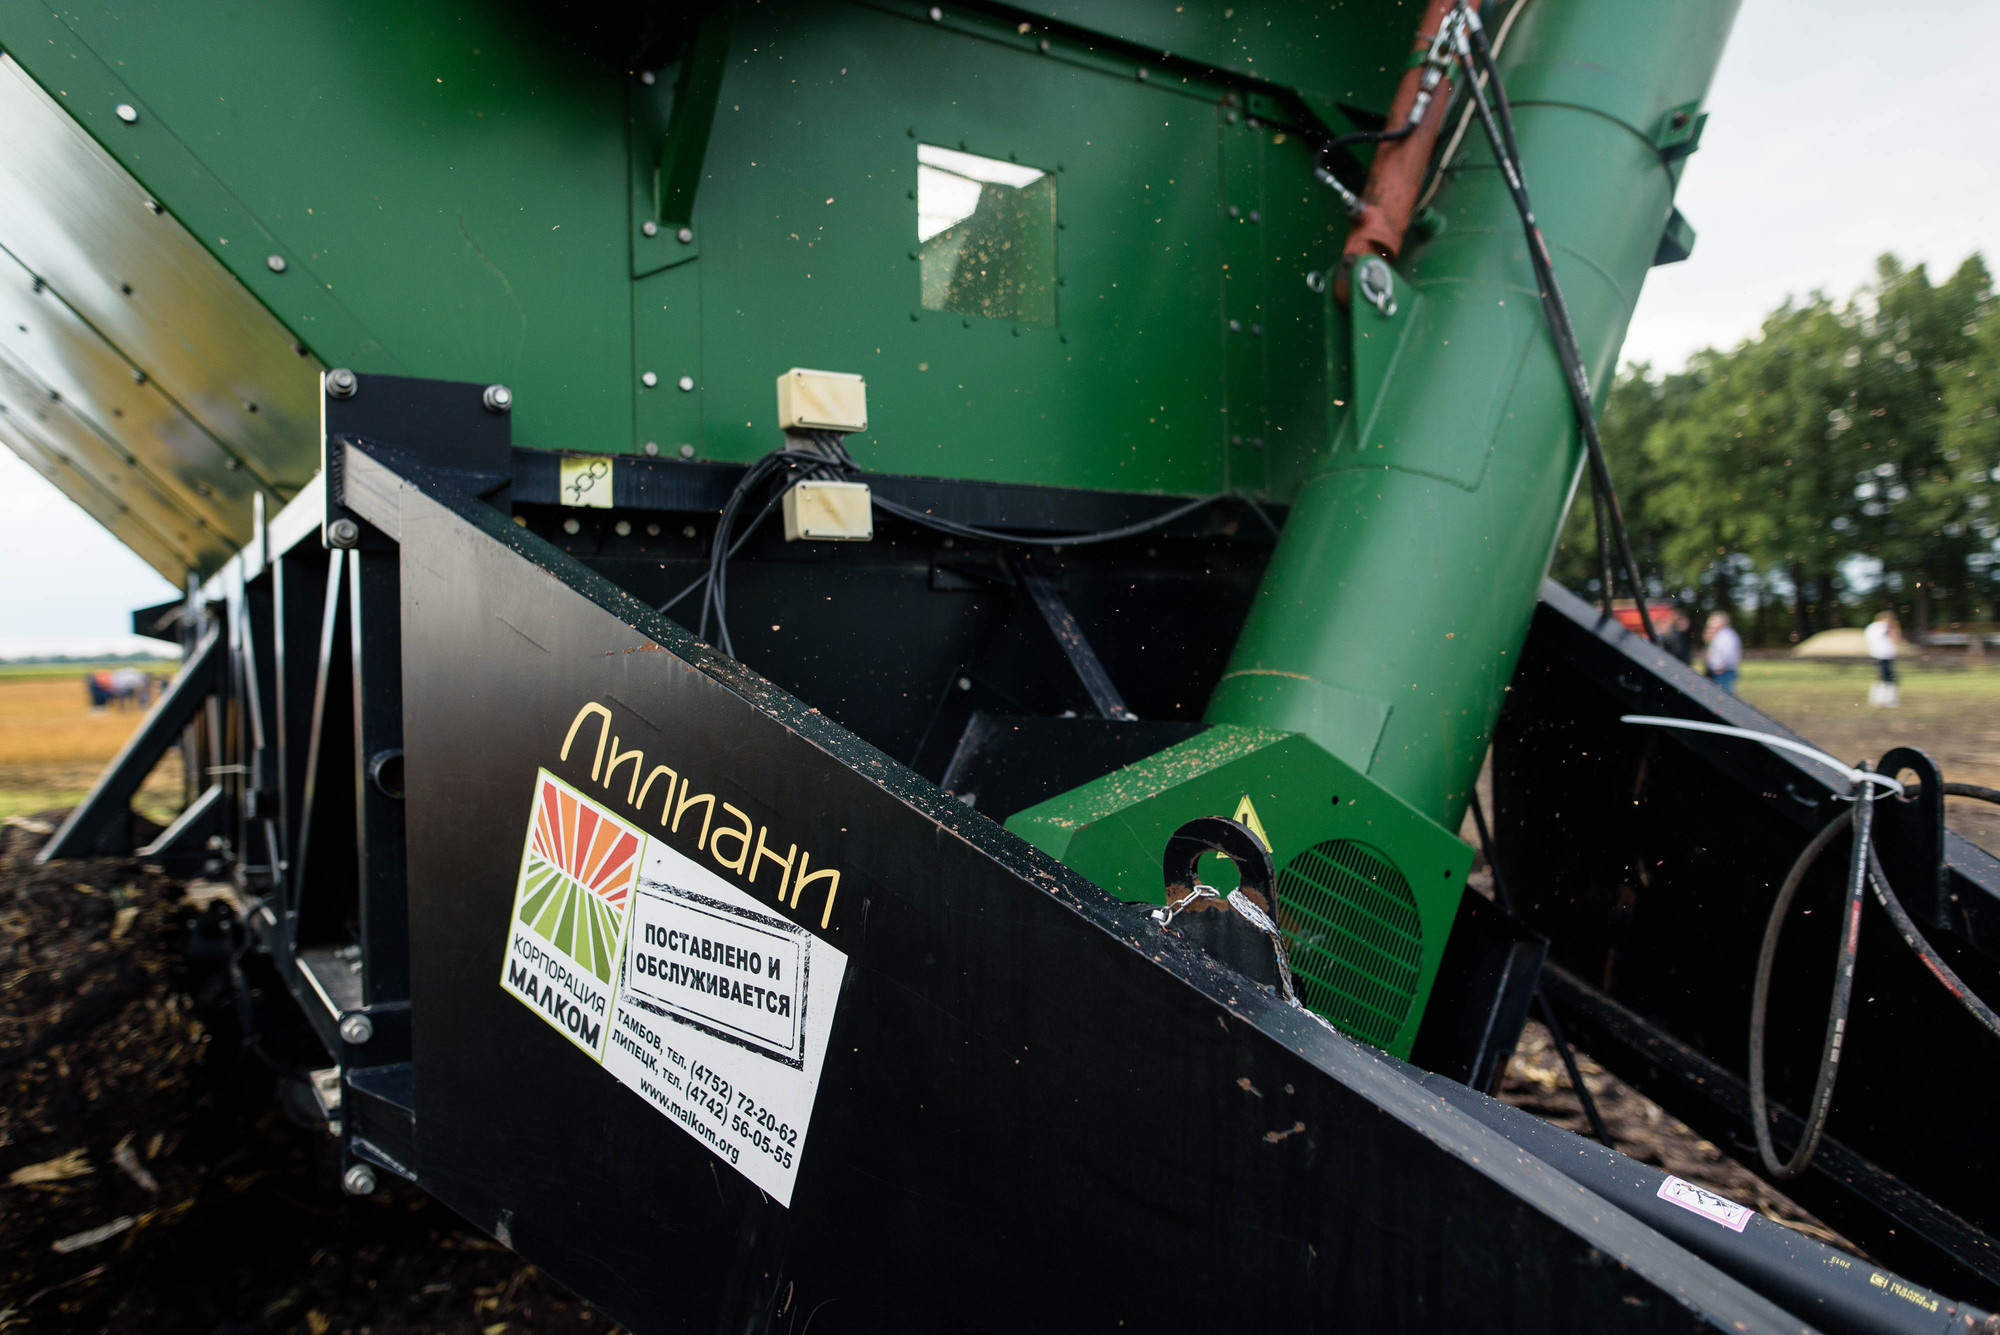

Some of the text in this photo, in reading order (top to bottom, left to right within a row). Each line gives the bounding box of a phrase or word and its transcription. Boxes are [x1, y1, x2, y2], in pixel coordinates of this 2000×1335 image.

[560, 701, 841, 930] Лилиани
[513, 933, 606, 1017] КОРПОРАЦИЯ
[635, 952, 791, 1018] ОБСЛУЖИВАЕТСЯ
[645, 922, 781, 981] ПОСТАВЛЕНО И
[508, 958, 601, 1050] МАЛКОМ
[612, 1028, 659, 1076] ЛИПЕЦК,
[686, 1082, 728, 1127] (4742)
[731, 1114, 793, 1169] 56-05-55
[617, 1007, 664, 1054] ТАМБОВ,
[690, 1060, 733, 1105] (4752)
[737, 1092, 798, 1148] 72-20-62
[640, 1077, 740, 1165] www.malkom.org
